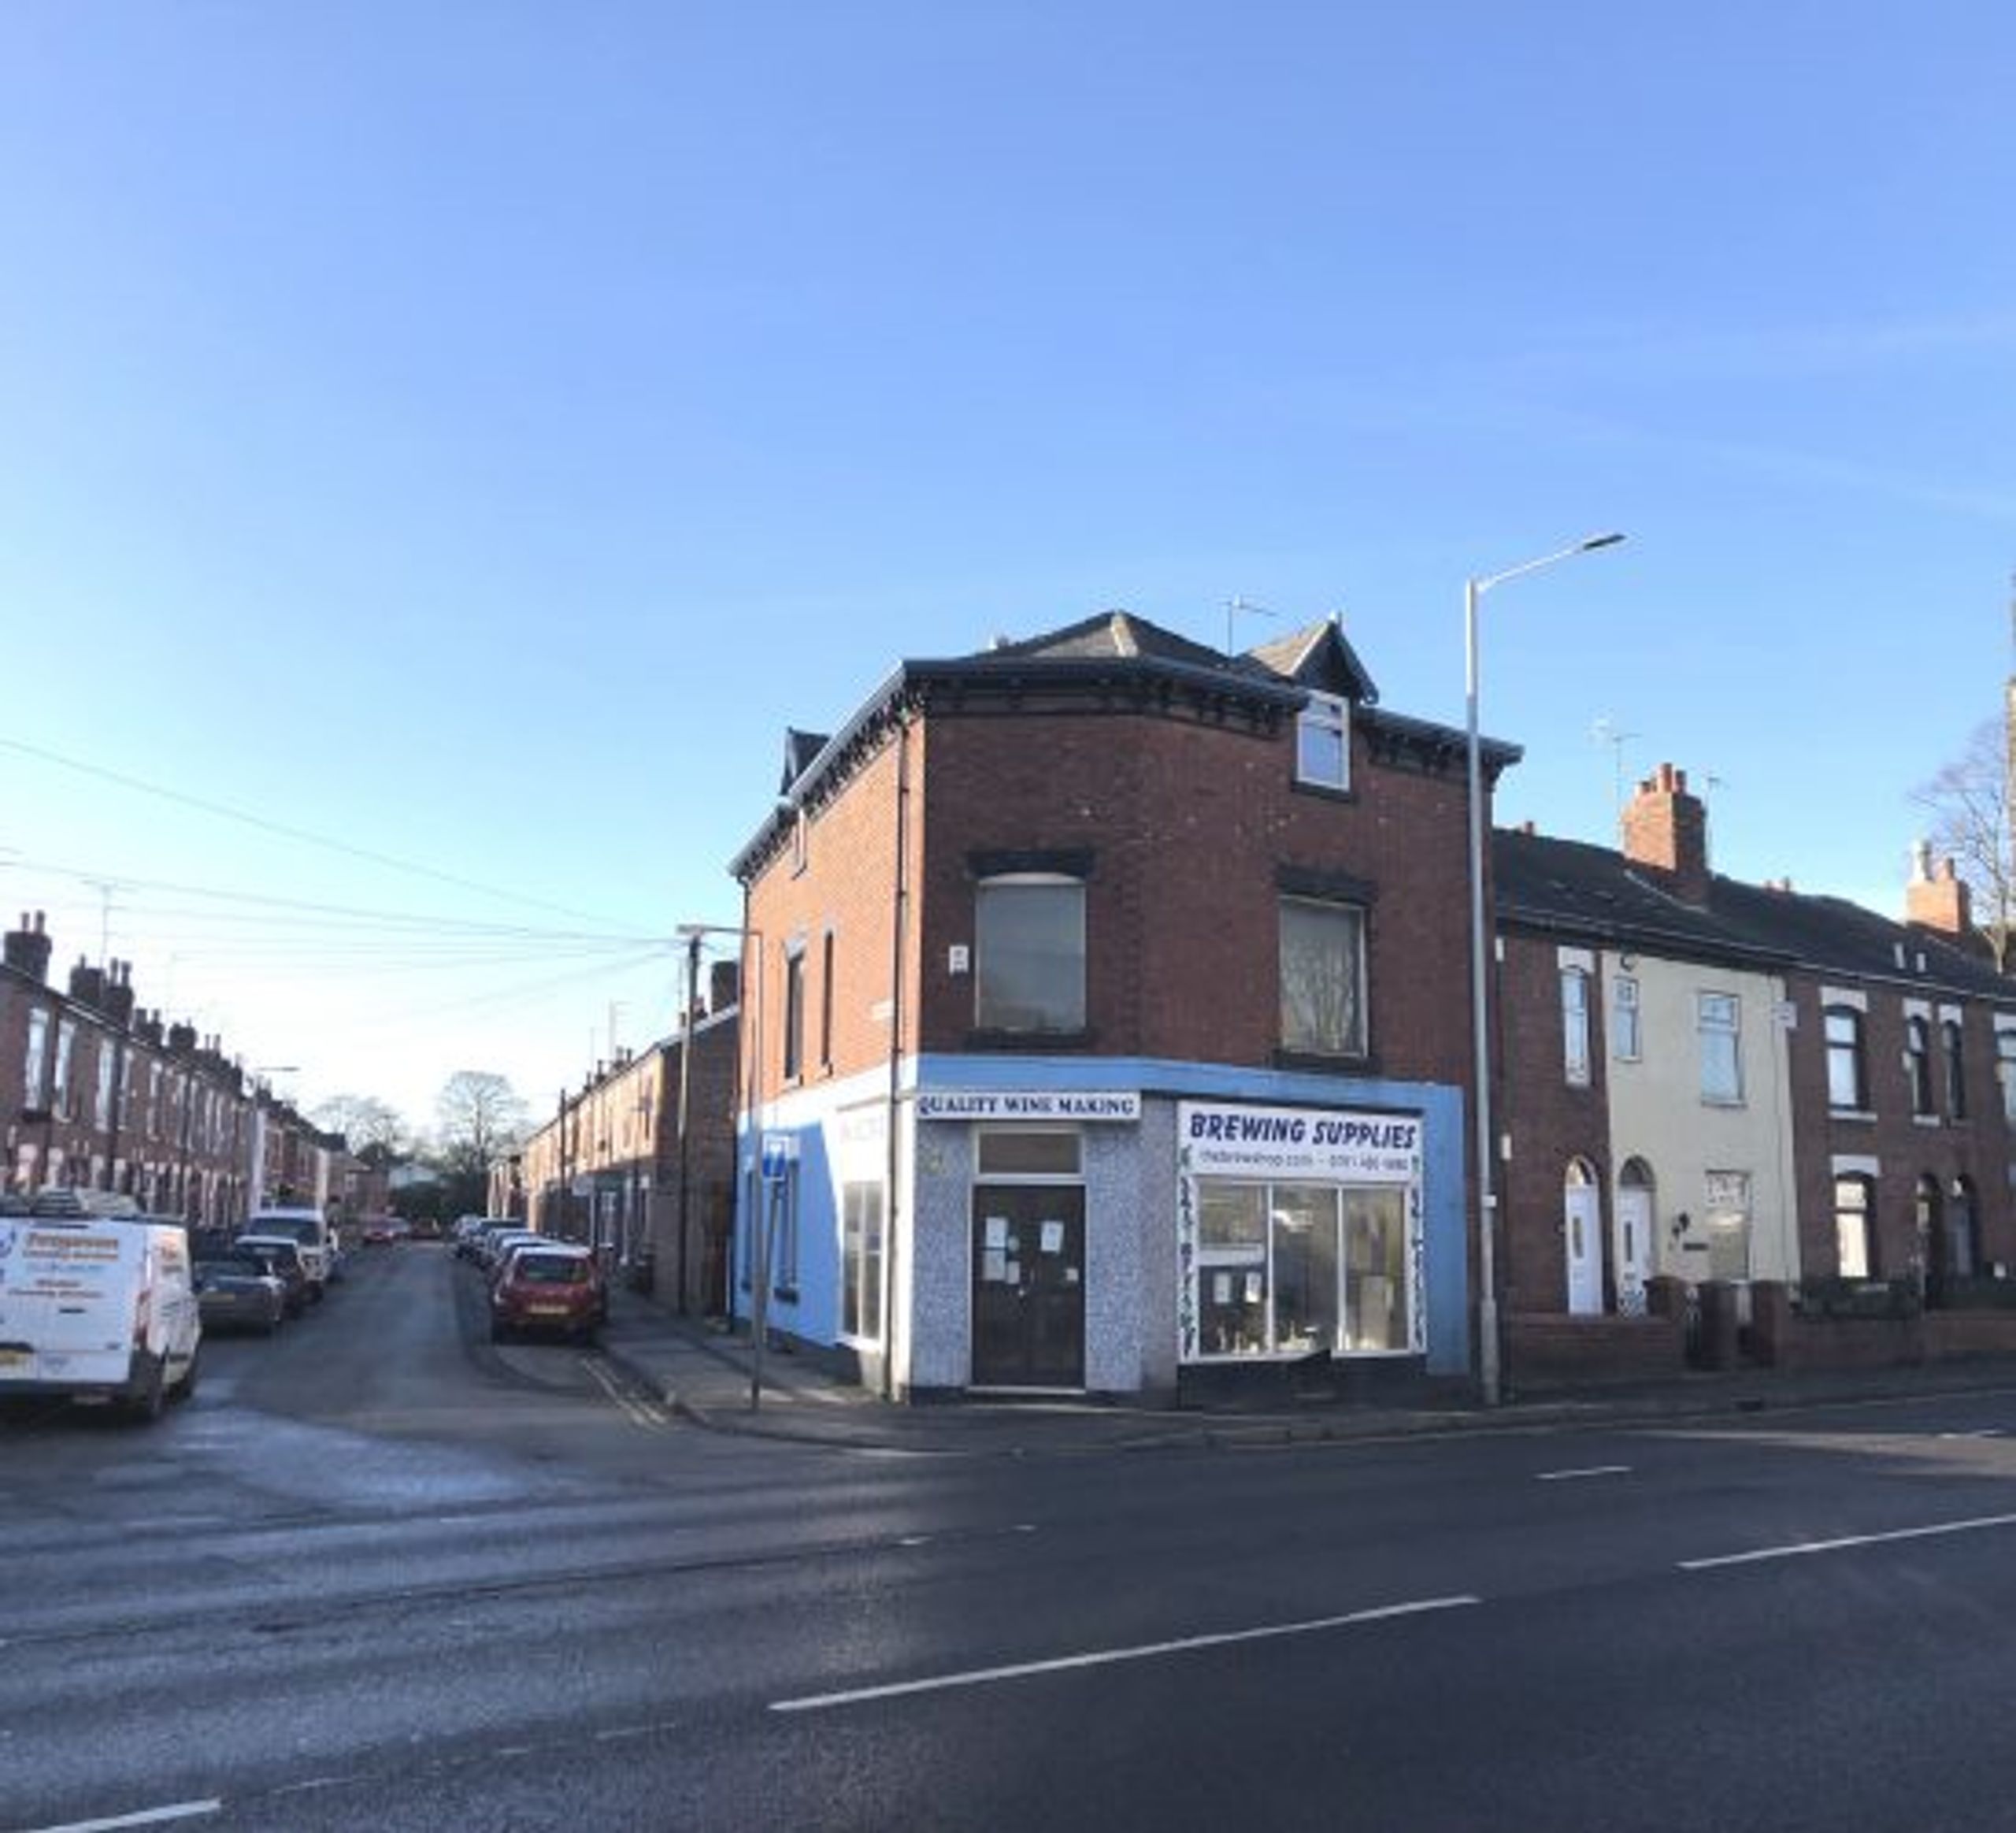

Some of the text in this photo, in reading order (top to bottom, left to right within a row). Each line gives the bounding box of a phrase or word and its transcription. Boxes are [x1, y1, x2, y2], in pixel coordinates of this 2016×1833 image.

[919, 1095, 1134, 1115] QUALITY WINE MAKING
[1190, 1112, 1417, 1148] BREWING SUPPLIES
